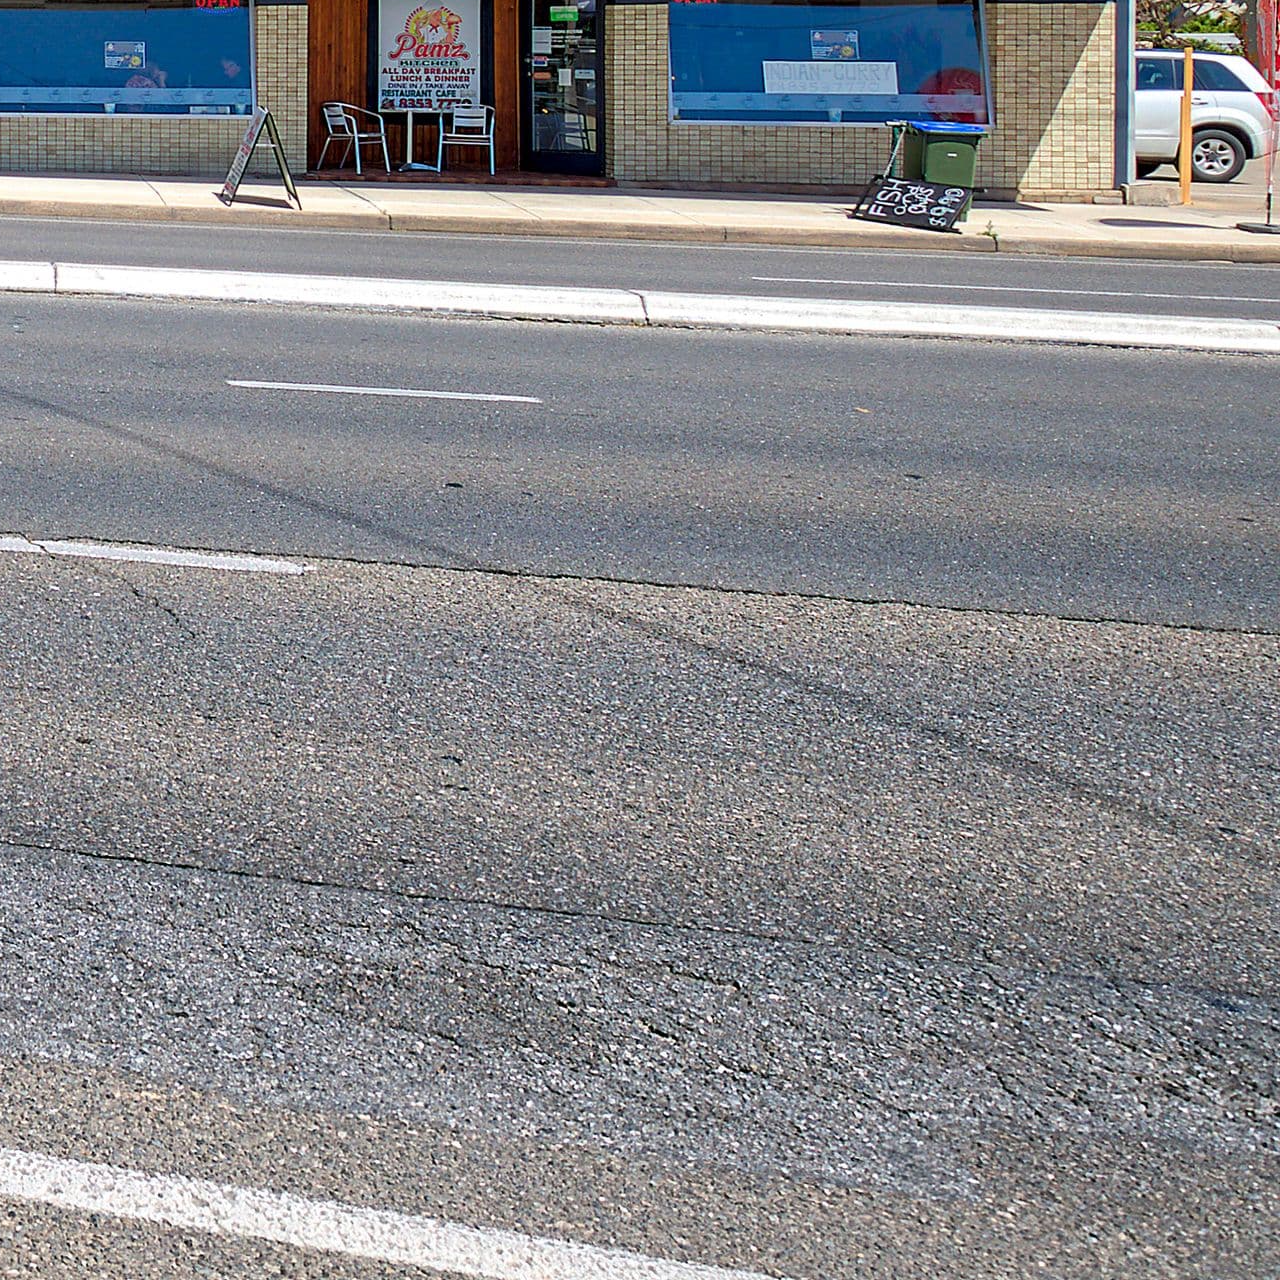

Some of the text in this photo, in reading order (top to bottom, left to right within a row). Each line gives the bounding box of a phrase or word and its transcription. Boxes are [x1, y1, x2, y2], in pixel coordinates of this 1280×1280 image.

[389, 33, 469, 59] Pamz
[398, 99, 433, 109] 8353
[868, 178, 912, 217] FISH
[894, 184, 922, 216] and
